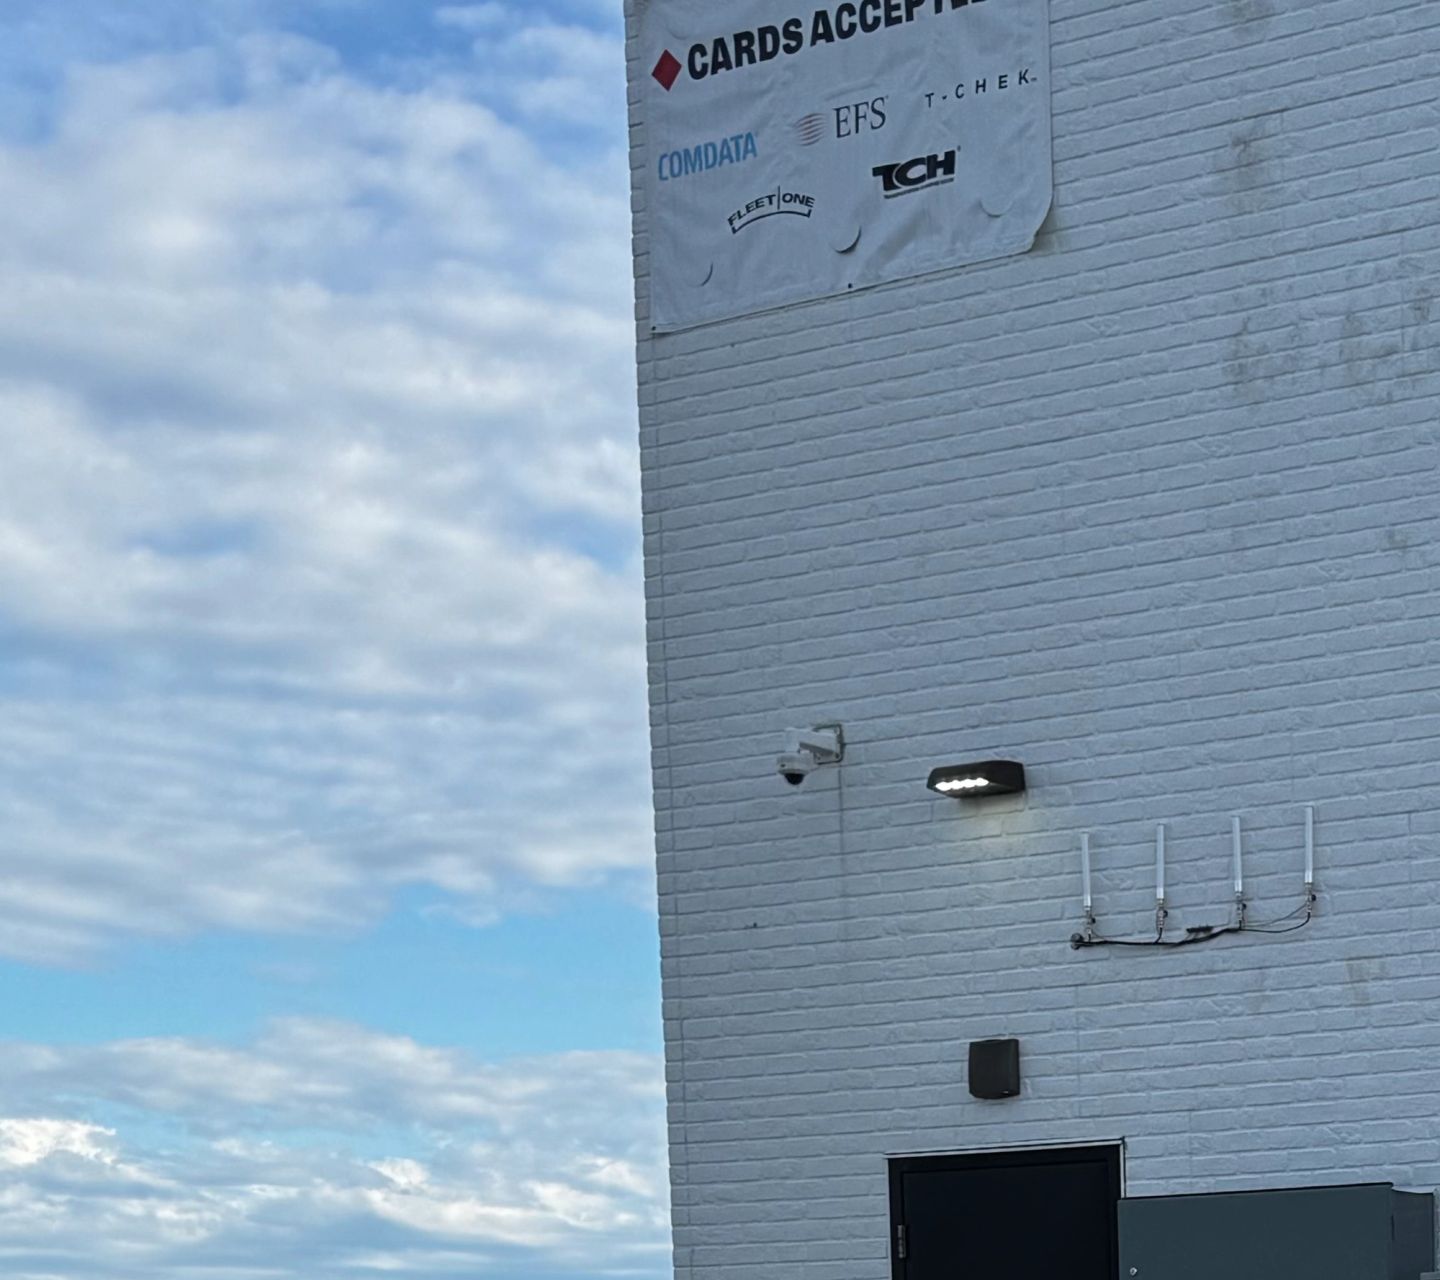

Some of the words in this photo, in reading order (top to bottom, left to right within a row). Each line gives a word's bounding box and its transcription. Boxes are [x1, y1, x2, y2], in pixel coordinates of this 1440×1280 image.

[688, 18, 803, 80] CARDS
[810, 0, 985, 46] ACCEP
[833, 97, 886, 138] EFS
[658, 132, 757, 181] COMDATA
[872, 150, 956, 191] TCH
